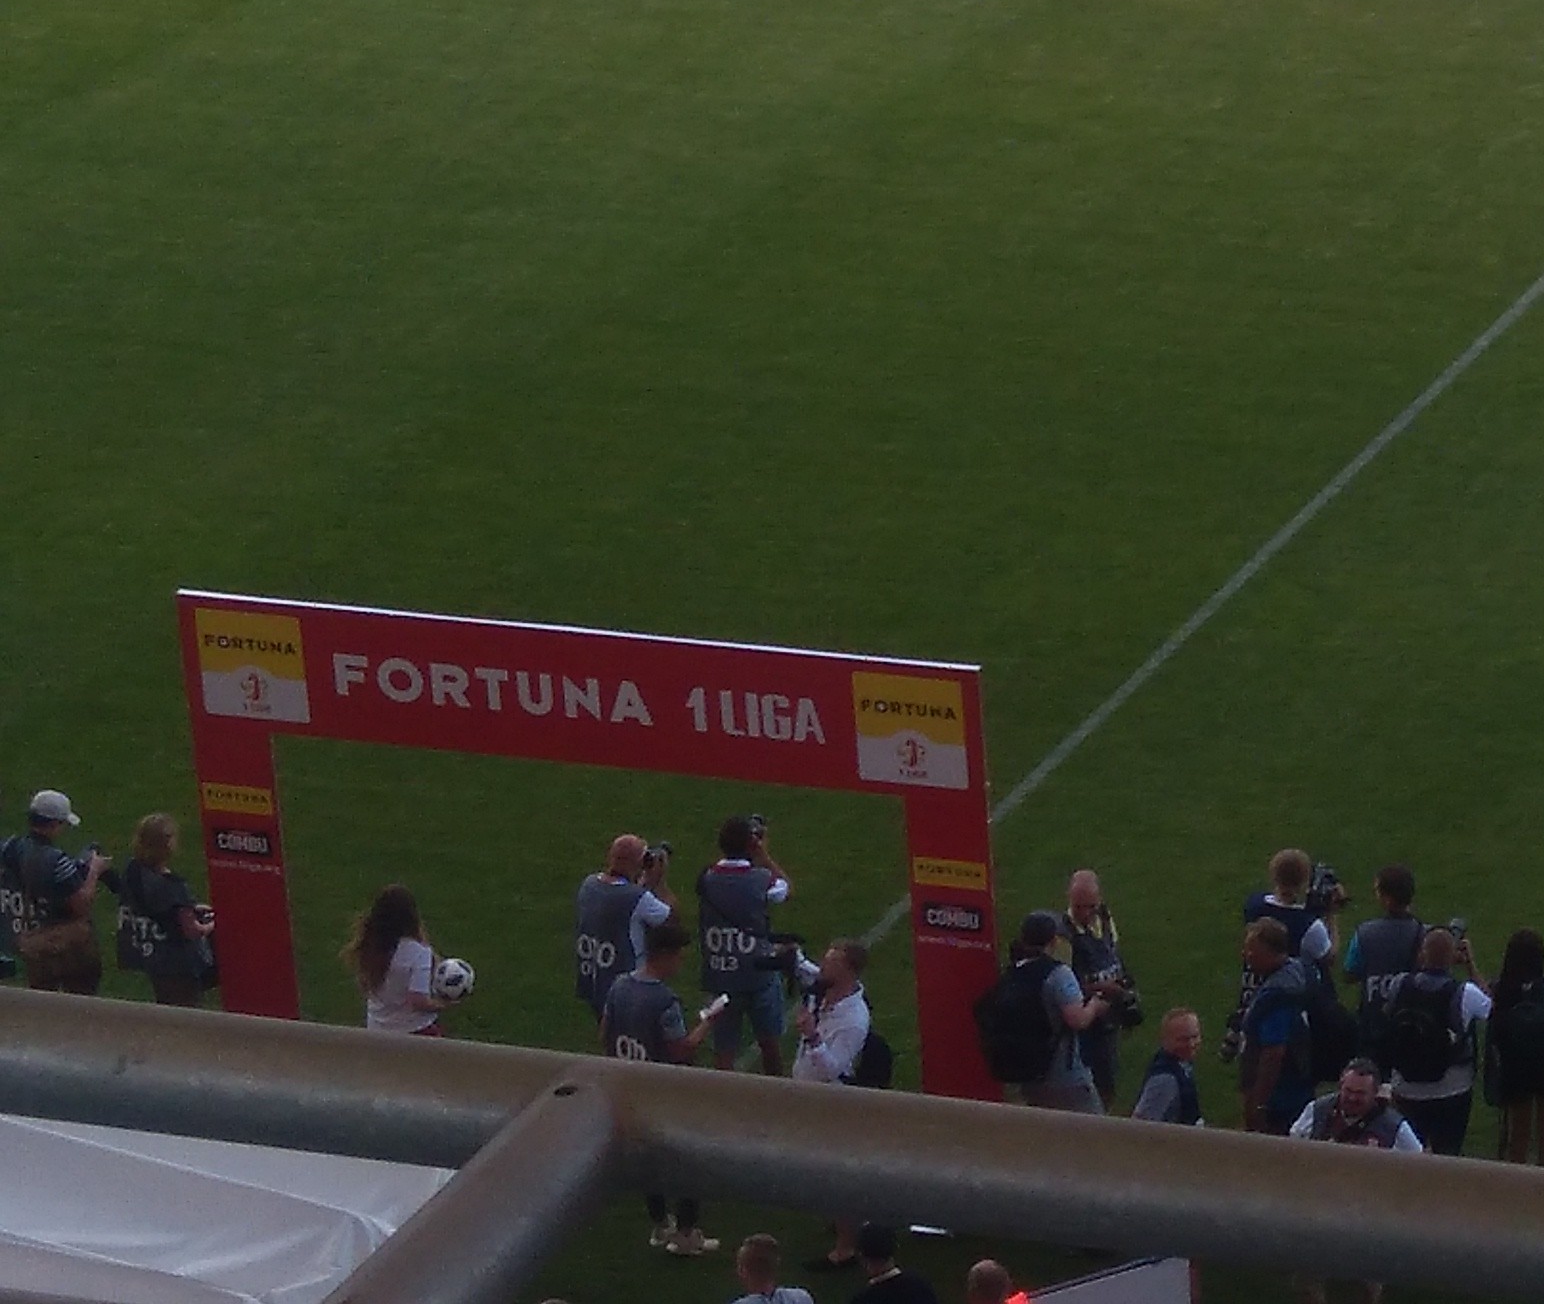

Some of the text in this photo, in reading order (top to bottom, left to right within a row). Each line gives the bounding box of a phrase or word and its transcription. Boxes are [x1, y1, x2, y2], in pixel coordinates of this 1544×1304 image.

[203, 634, 297, 655] FORTUNA
[332, 653, 654, 726] FORTUNA
[719, 690, 826, 745] LIGA
[860, 699, 957, 721] FORTUNA
